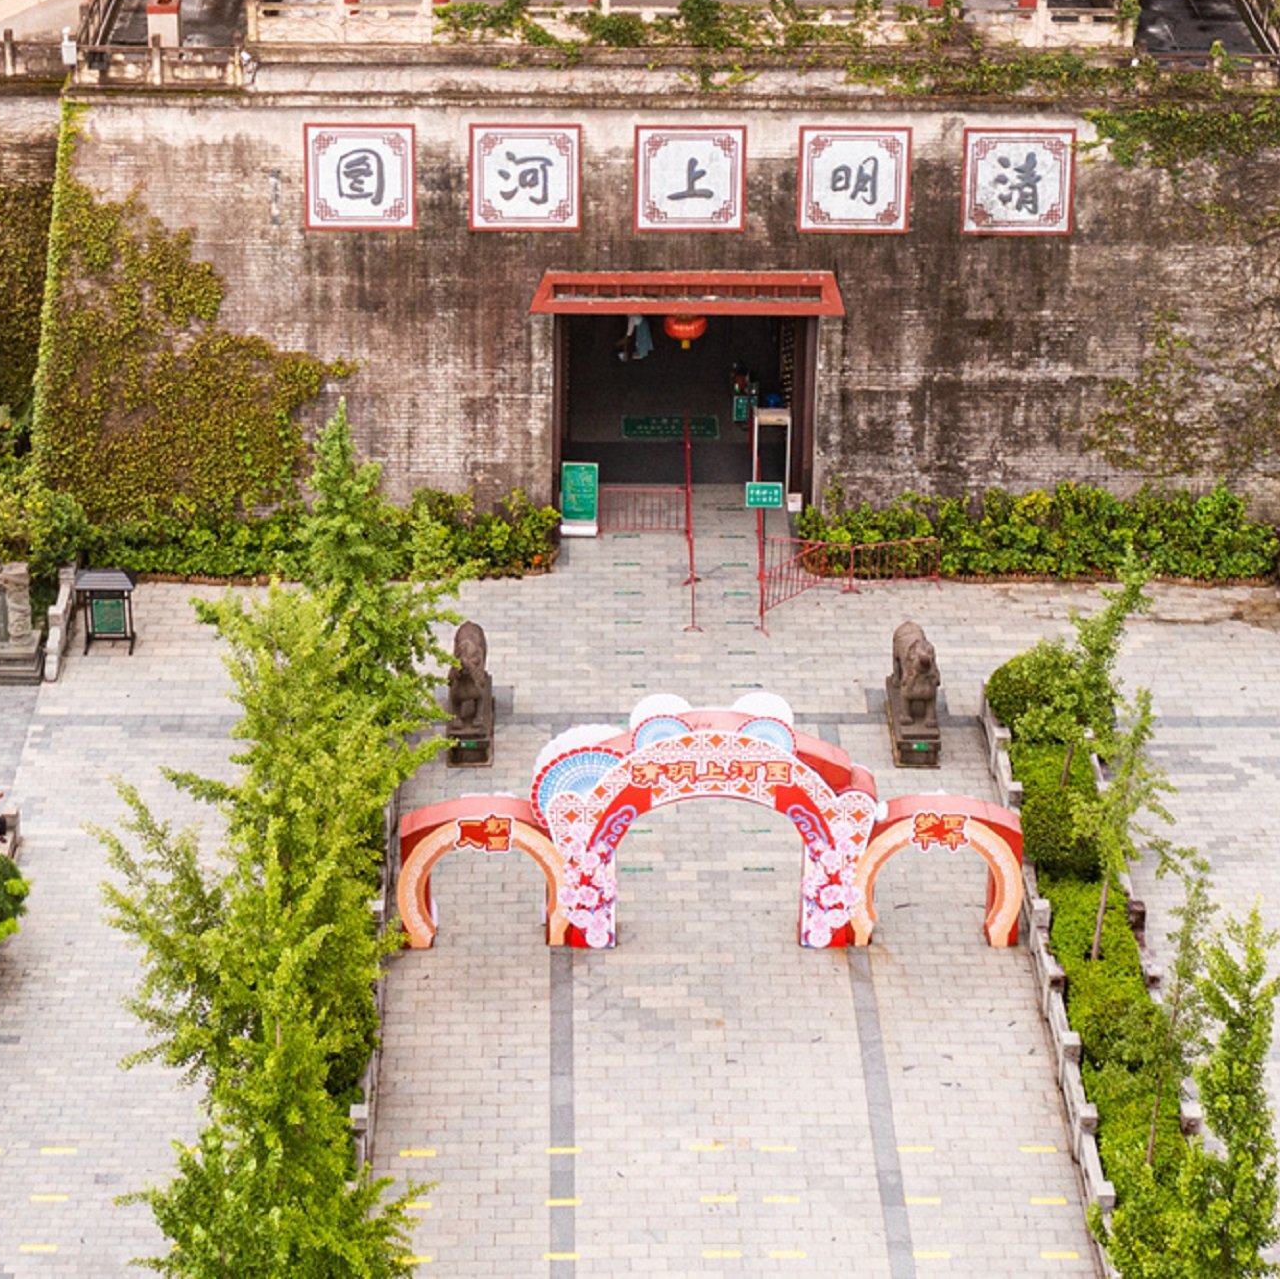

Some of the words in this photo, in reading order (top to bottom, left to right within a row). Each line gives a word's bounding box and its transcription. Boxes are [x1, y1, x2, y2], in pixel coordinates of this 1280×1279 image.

[631, 760, 793, 785] 清明上河图
